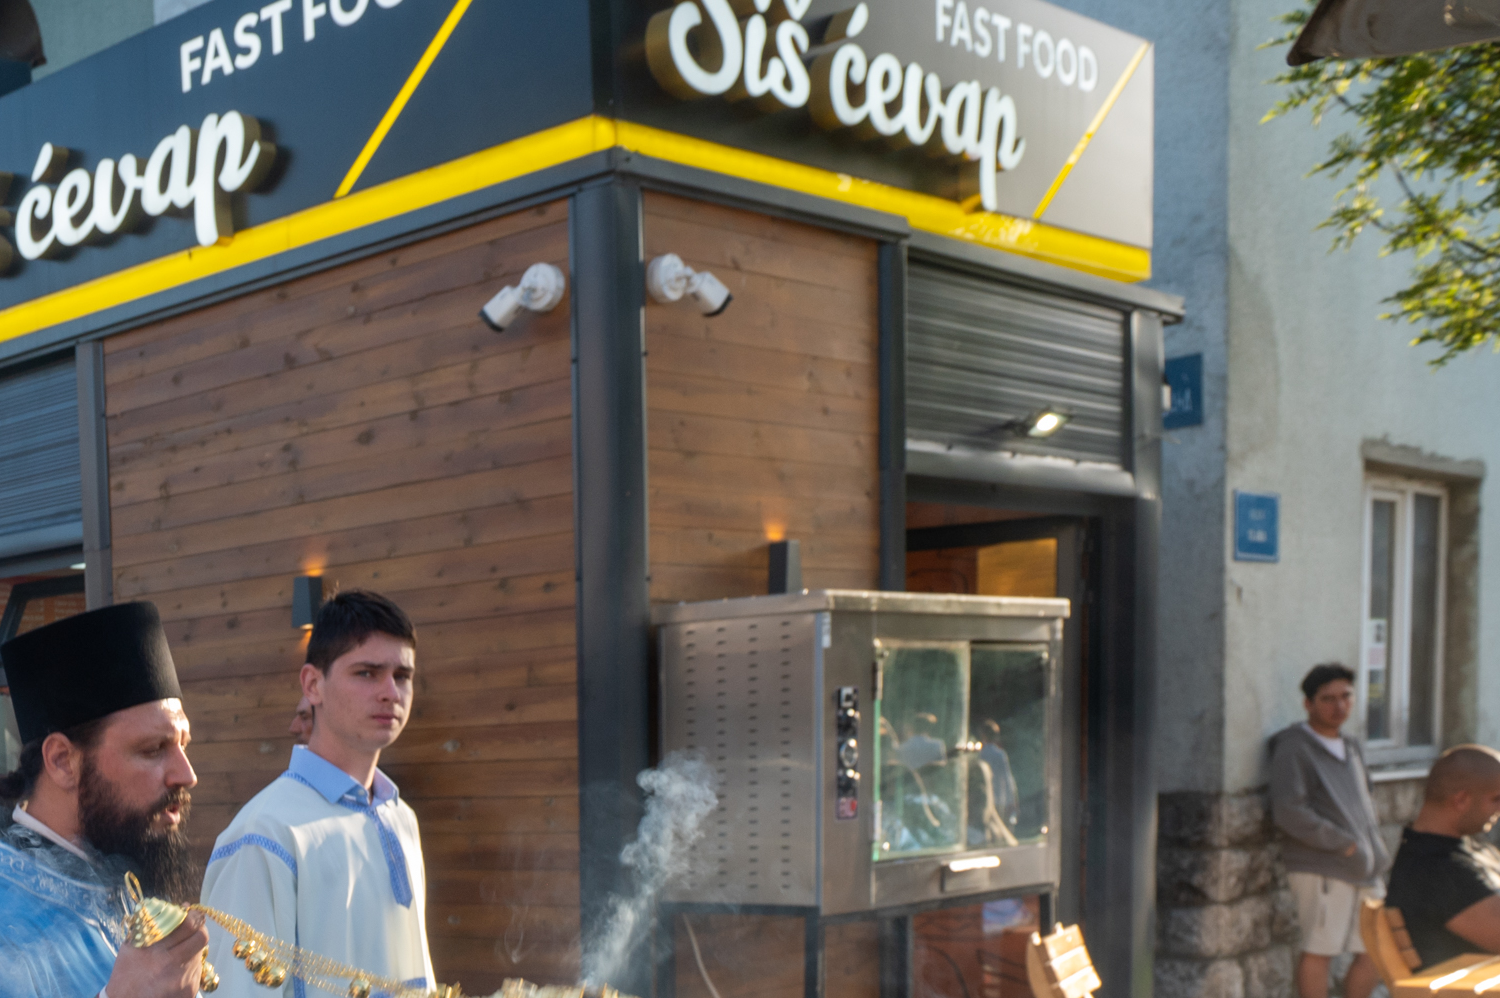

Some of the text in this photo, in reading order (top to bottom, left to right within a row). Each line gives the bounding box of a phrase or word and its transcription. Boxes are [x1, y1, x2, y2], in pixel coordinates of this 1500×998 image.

[180, 0, 293, 93] FAST
[829, 1, 1025, 211] ćevap
[935, 0, 1099, 92] FAST FOOD
[14, 110, 262, 260] ćevap
